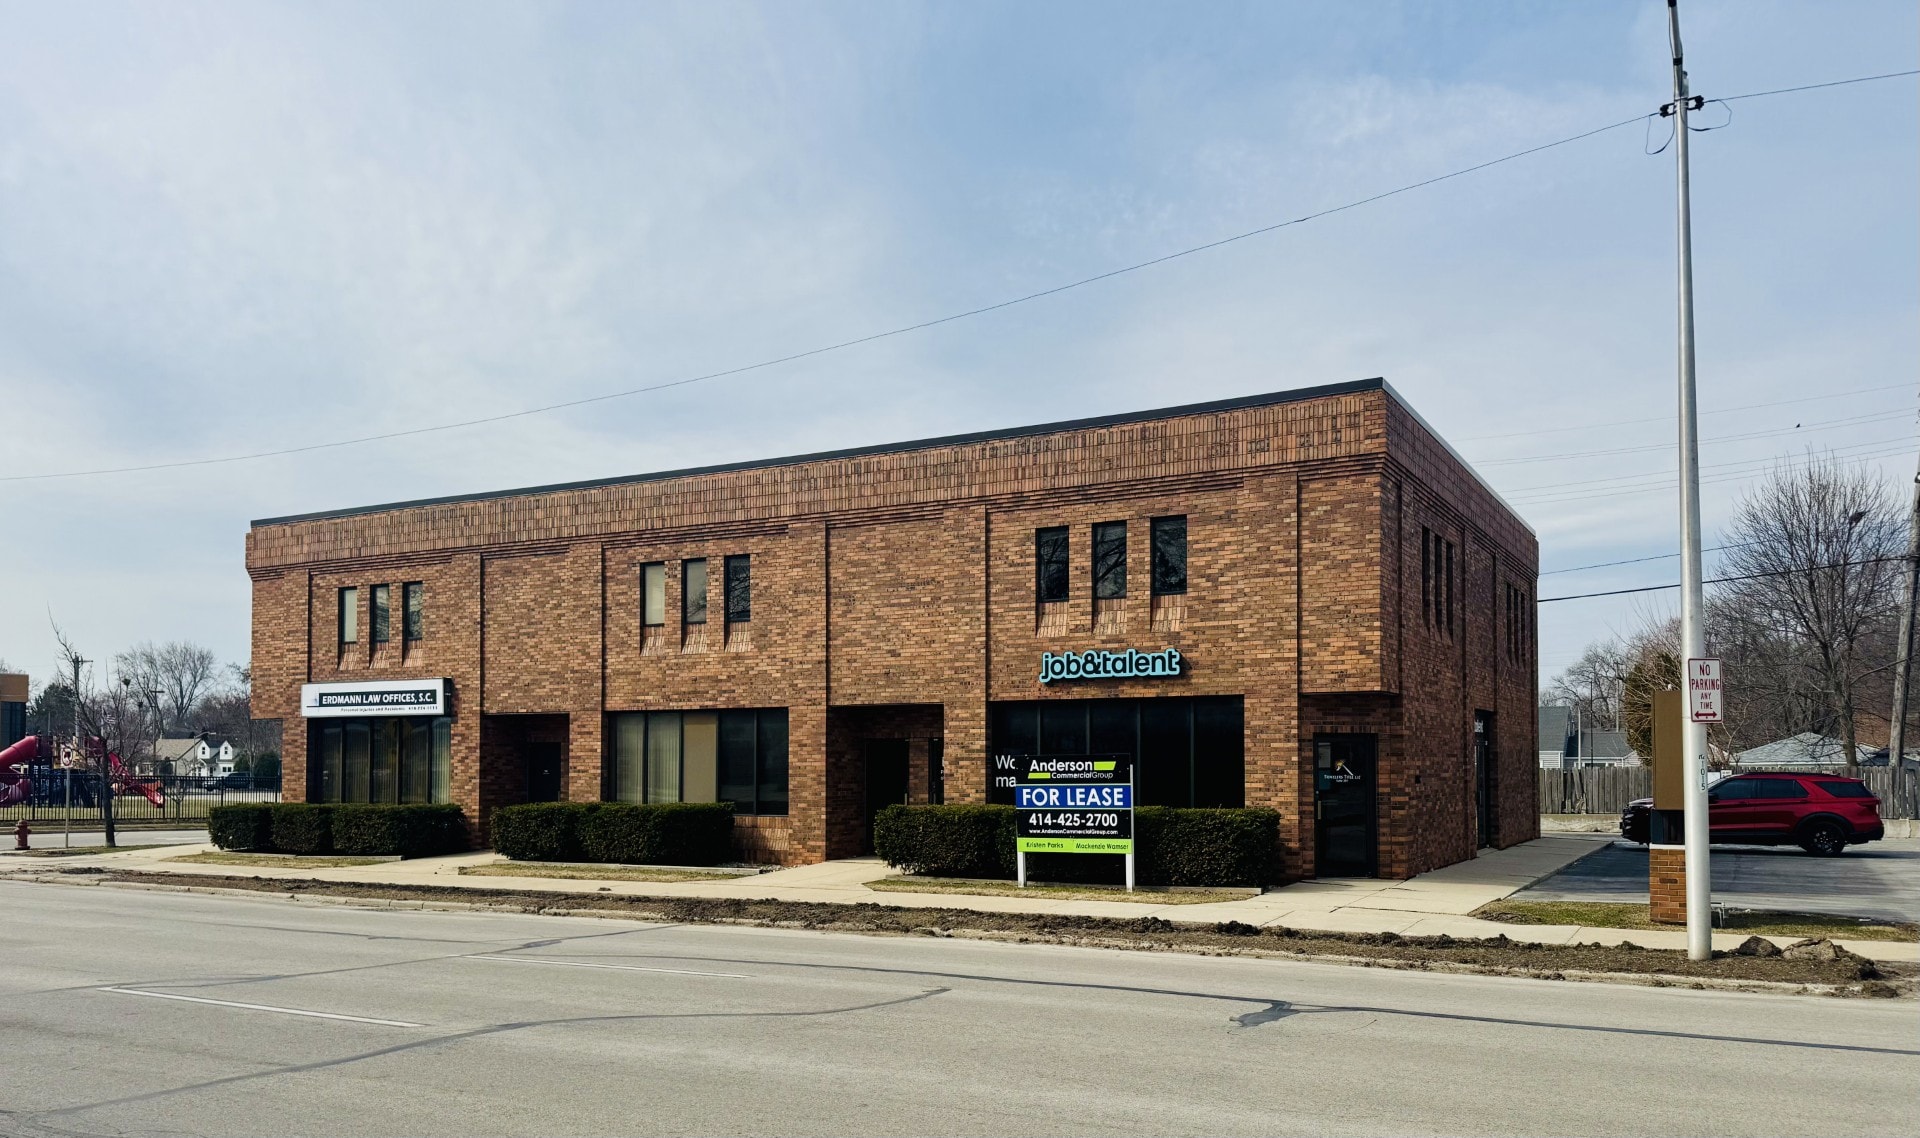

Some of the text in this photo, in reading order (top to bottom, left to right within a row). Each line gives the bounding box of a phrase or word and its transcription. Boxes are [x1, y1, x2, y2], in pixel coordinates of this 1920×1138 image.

[1040, 649, 1179, 681] job&talent
[1699, 664, 1711, 676] NO
[1691, 678, 1720, 691] PARKING
[322, 692, 433, 705] ERDMANN LAW OFFICES, S.C.
[1700, 692, 1712, 700] ANY
[1700, 701, 1713, 710] TIME
[1029, 759, 1093, 771] Anderson
[1022, 787, 1124, 806] FOR LEASE
[1028, 813, 1118, 827] 414-425-2700
[1028, 828, 1118, 836] www.AndersonCommercialGroup.com
